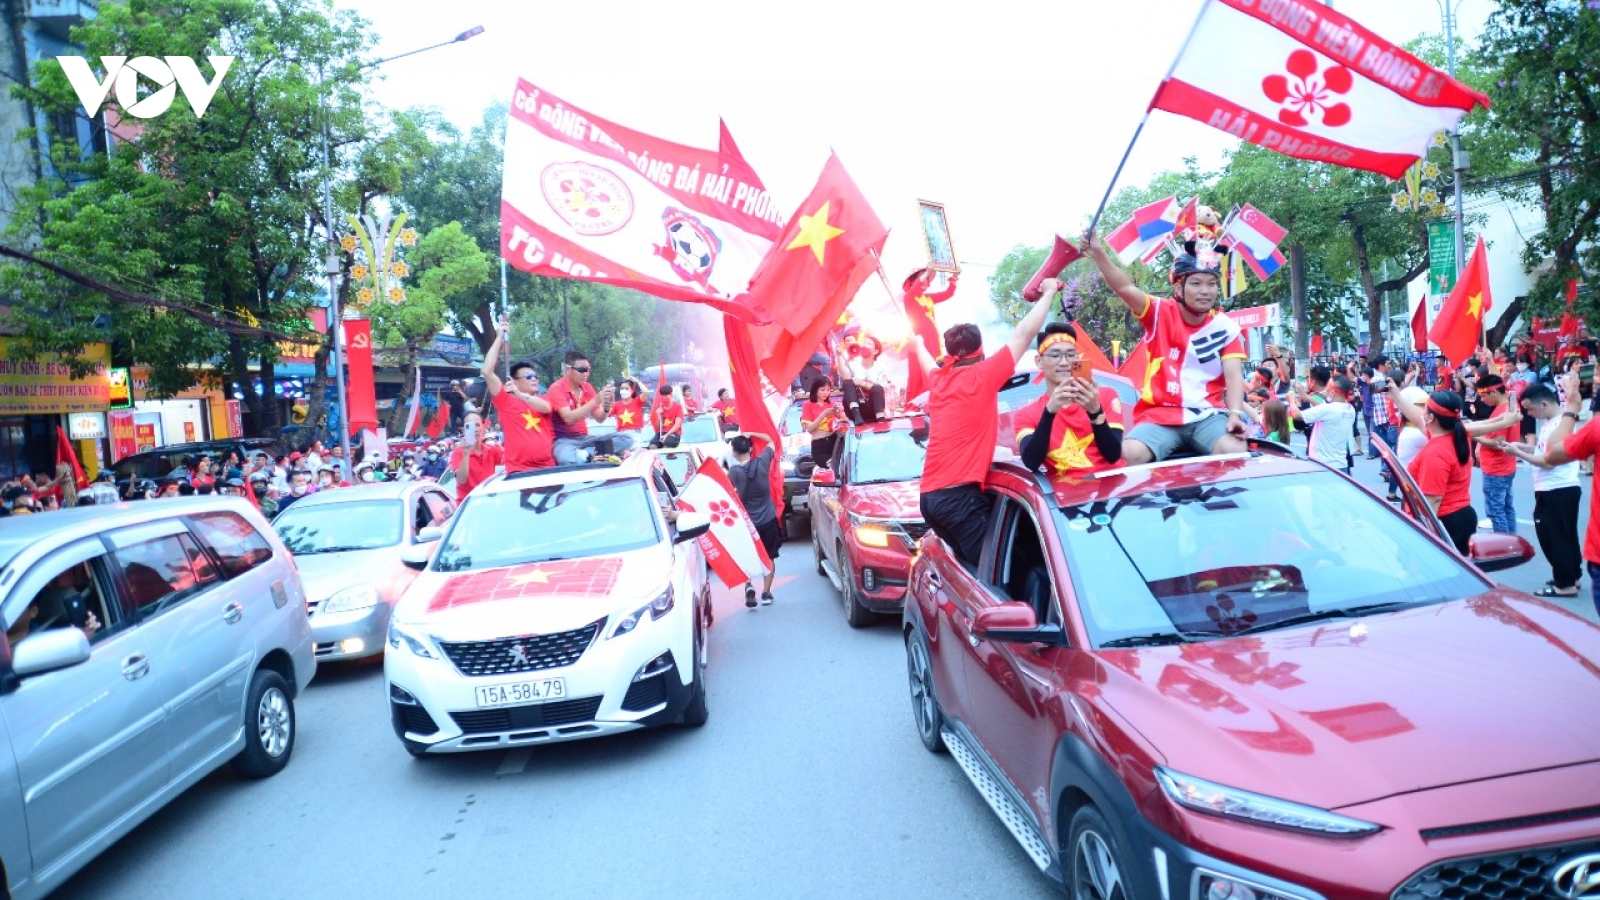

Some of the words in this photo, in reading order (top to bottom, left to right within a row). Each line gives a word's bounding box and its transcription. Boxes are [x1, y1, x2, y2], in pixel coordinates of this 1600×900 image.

[1315, 17, 1366, 63] VIÊN
[1360, 42, 1421, 92] BÓNG
[514, 88, 540, 114] CỔ
[673, 163, 701, 194] ĐÁ
[699, 163, 735, 204] HẢI
[1208, 108, 1259, 143] HẢI
[1259, 128, 1355, 162] PHÒNG
[508, 225, 545, 264] FC
[20, 361, 40, 375] SINH
[481, 680, 562, 703] 15A-584.79
